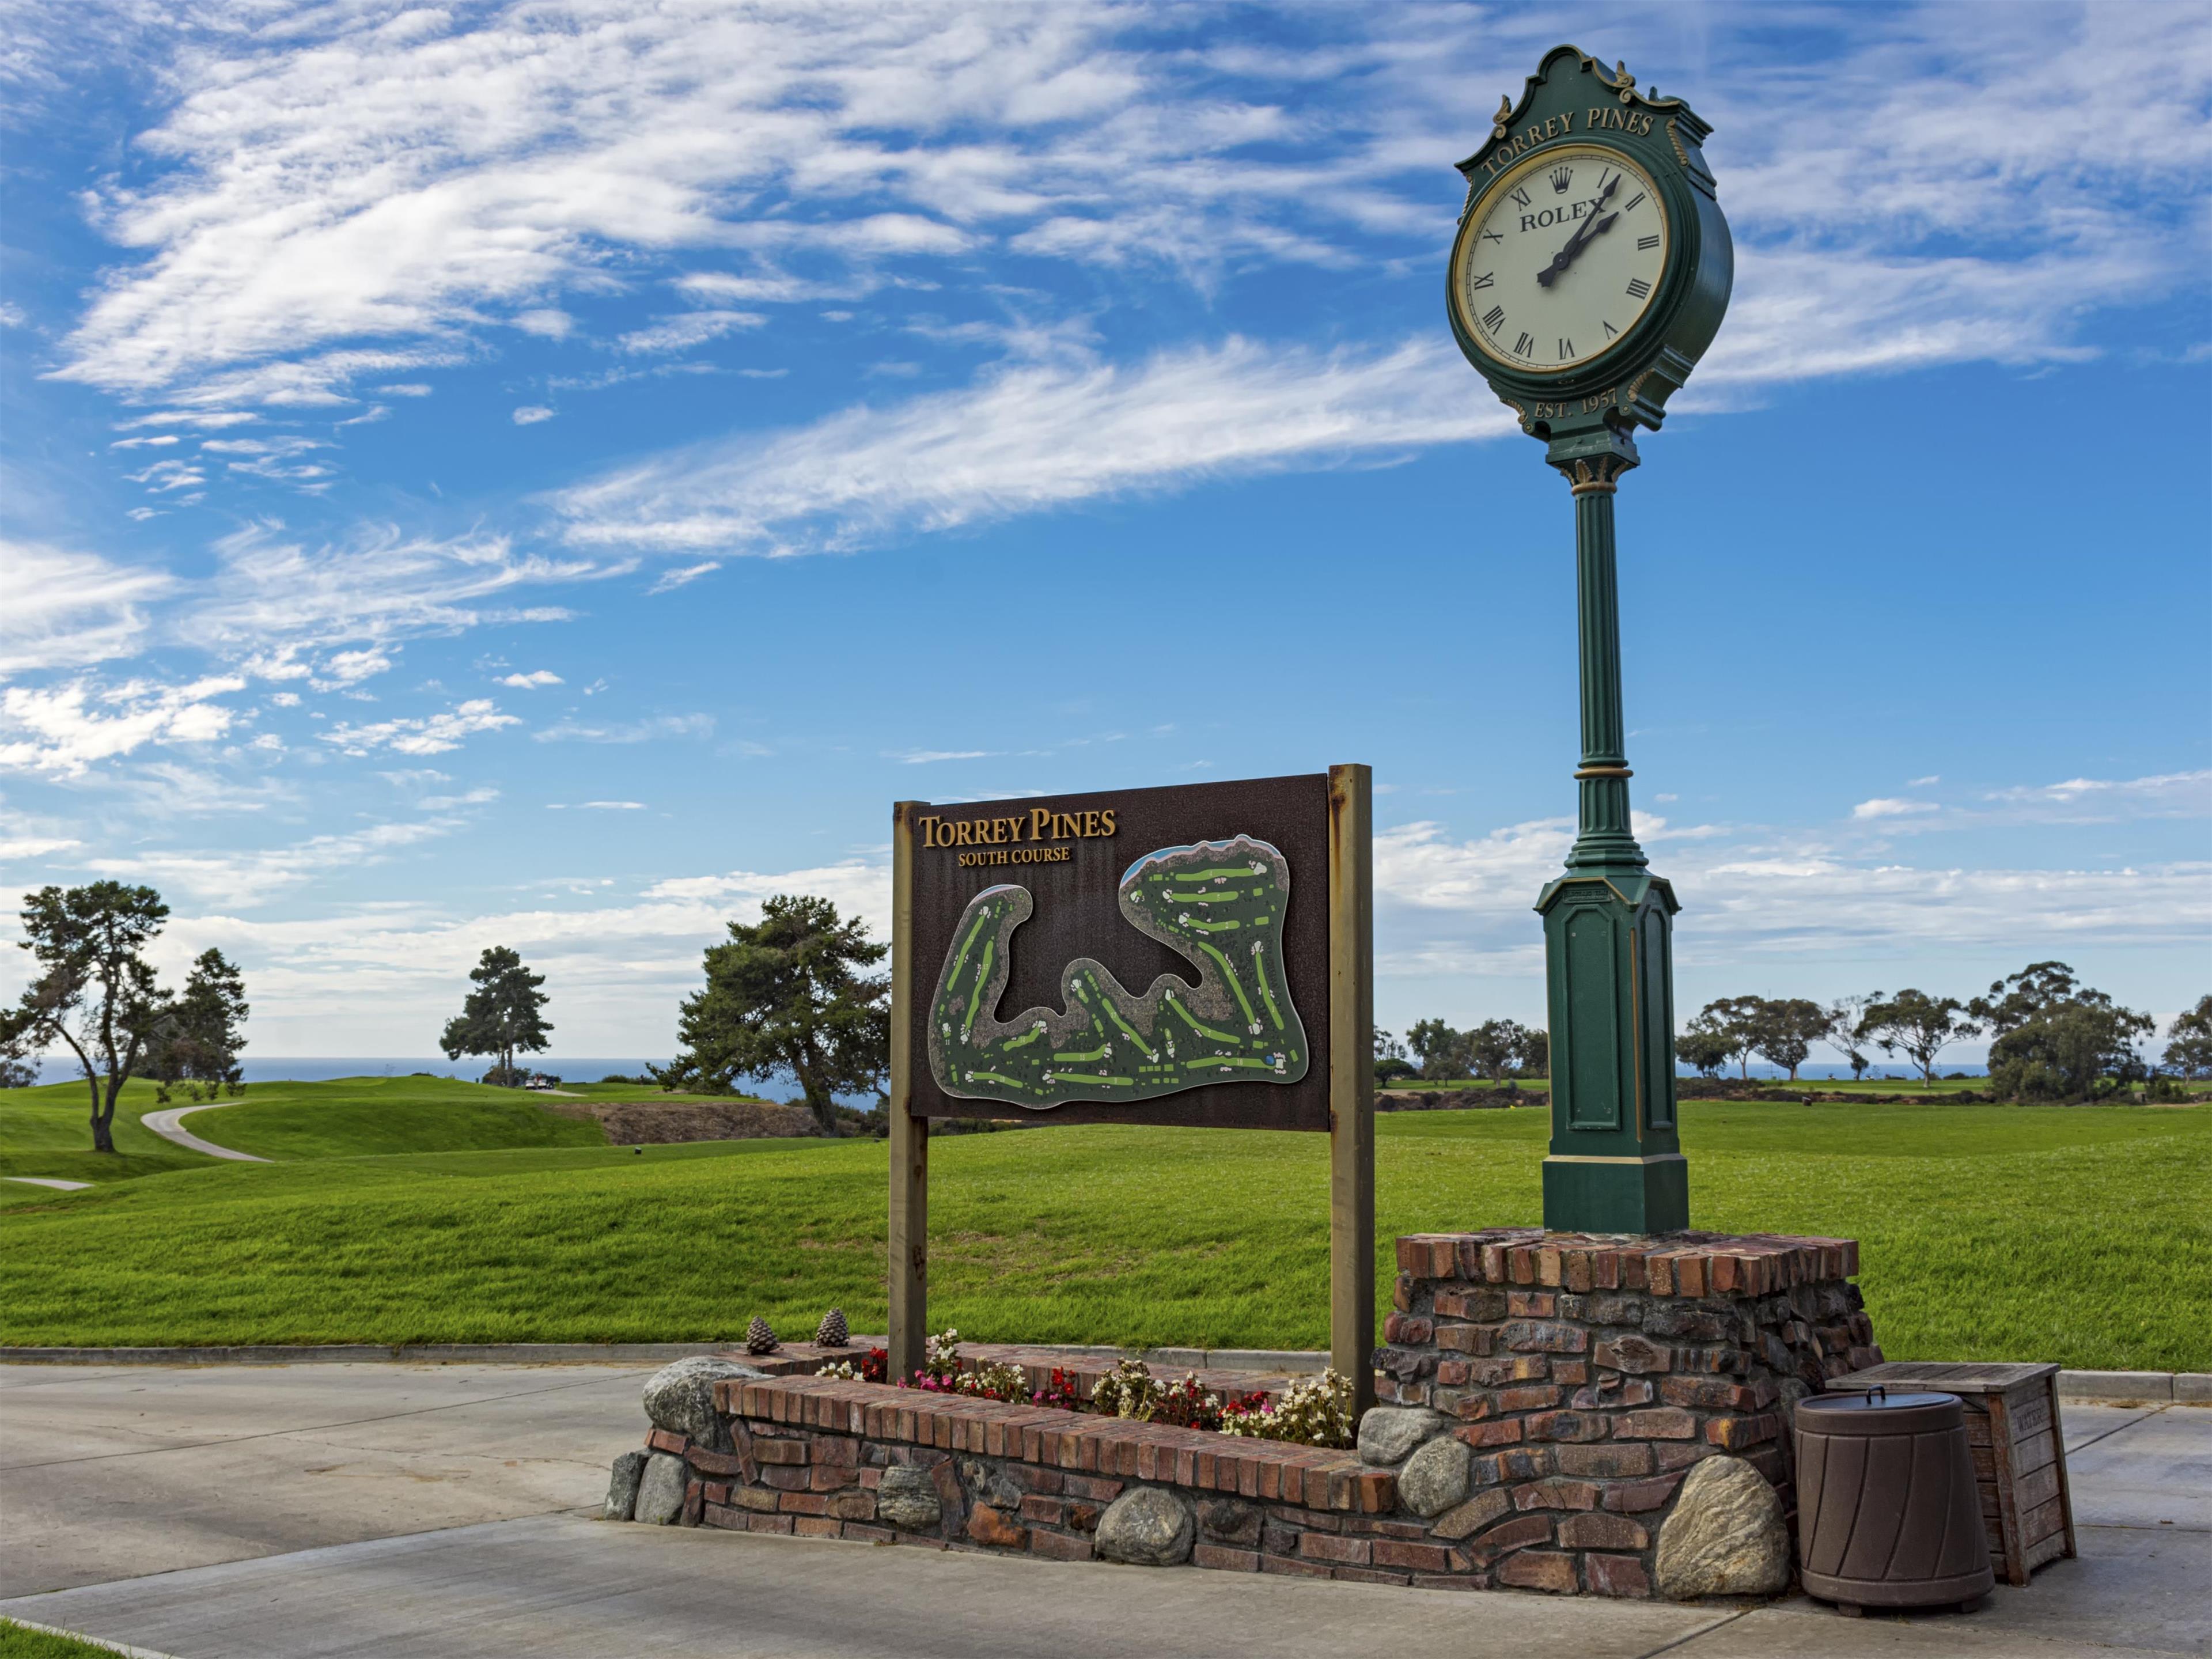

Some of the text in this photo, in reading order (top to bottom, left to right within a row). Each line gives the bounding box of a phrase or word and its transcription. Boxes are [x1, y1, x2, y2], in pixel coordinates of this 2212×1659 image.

[1480, 107, 1654, 176] TORREY PINES
[1509, 186, 1532, 212] XI
[1624, 191, 1646, 213] II
[1520, 196, 1606, 233] ROLEX
[1482, 228, 1504, 245] X
[1637, 233, 1660, 252] III
[1534, 387, 1618, 418] EST. 1957
[918, 808, 1116, 848] TORREY PINES
[958, 847, 1071, 867] SOUTH COURSE
